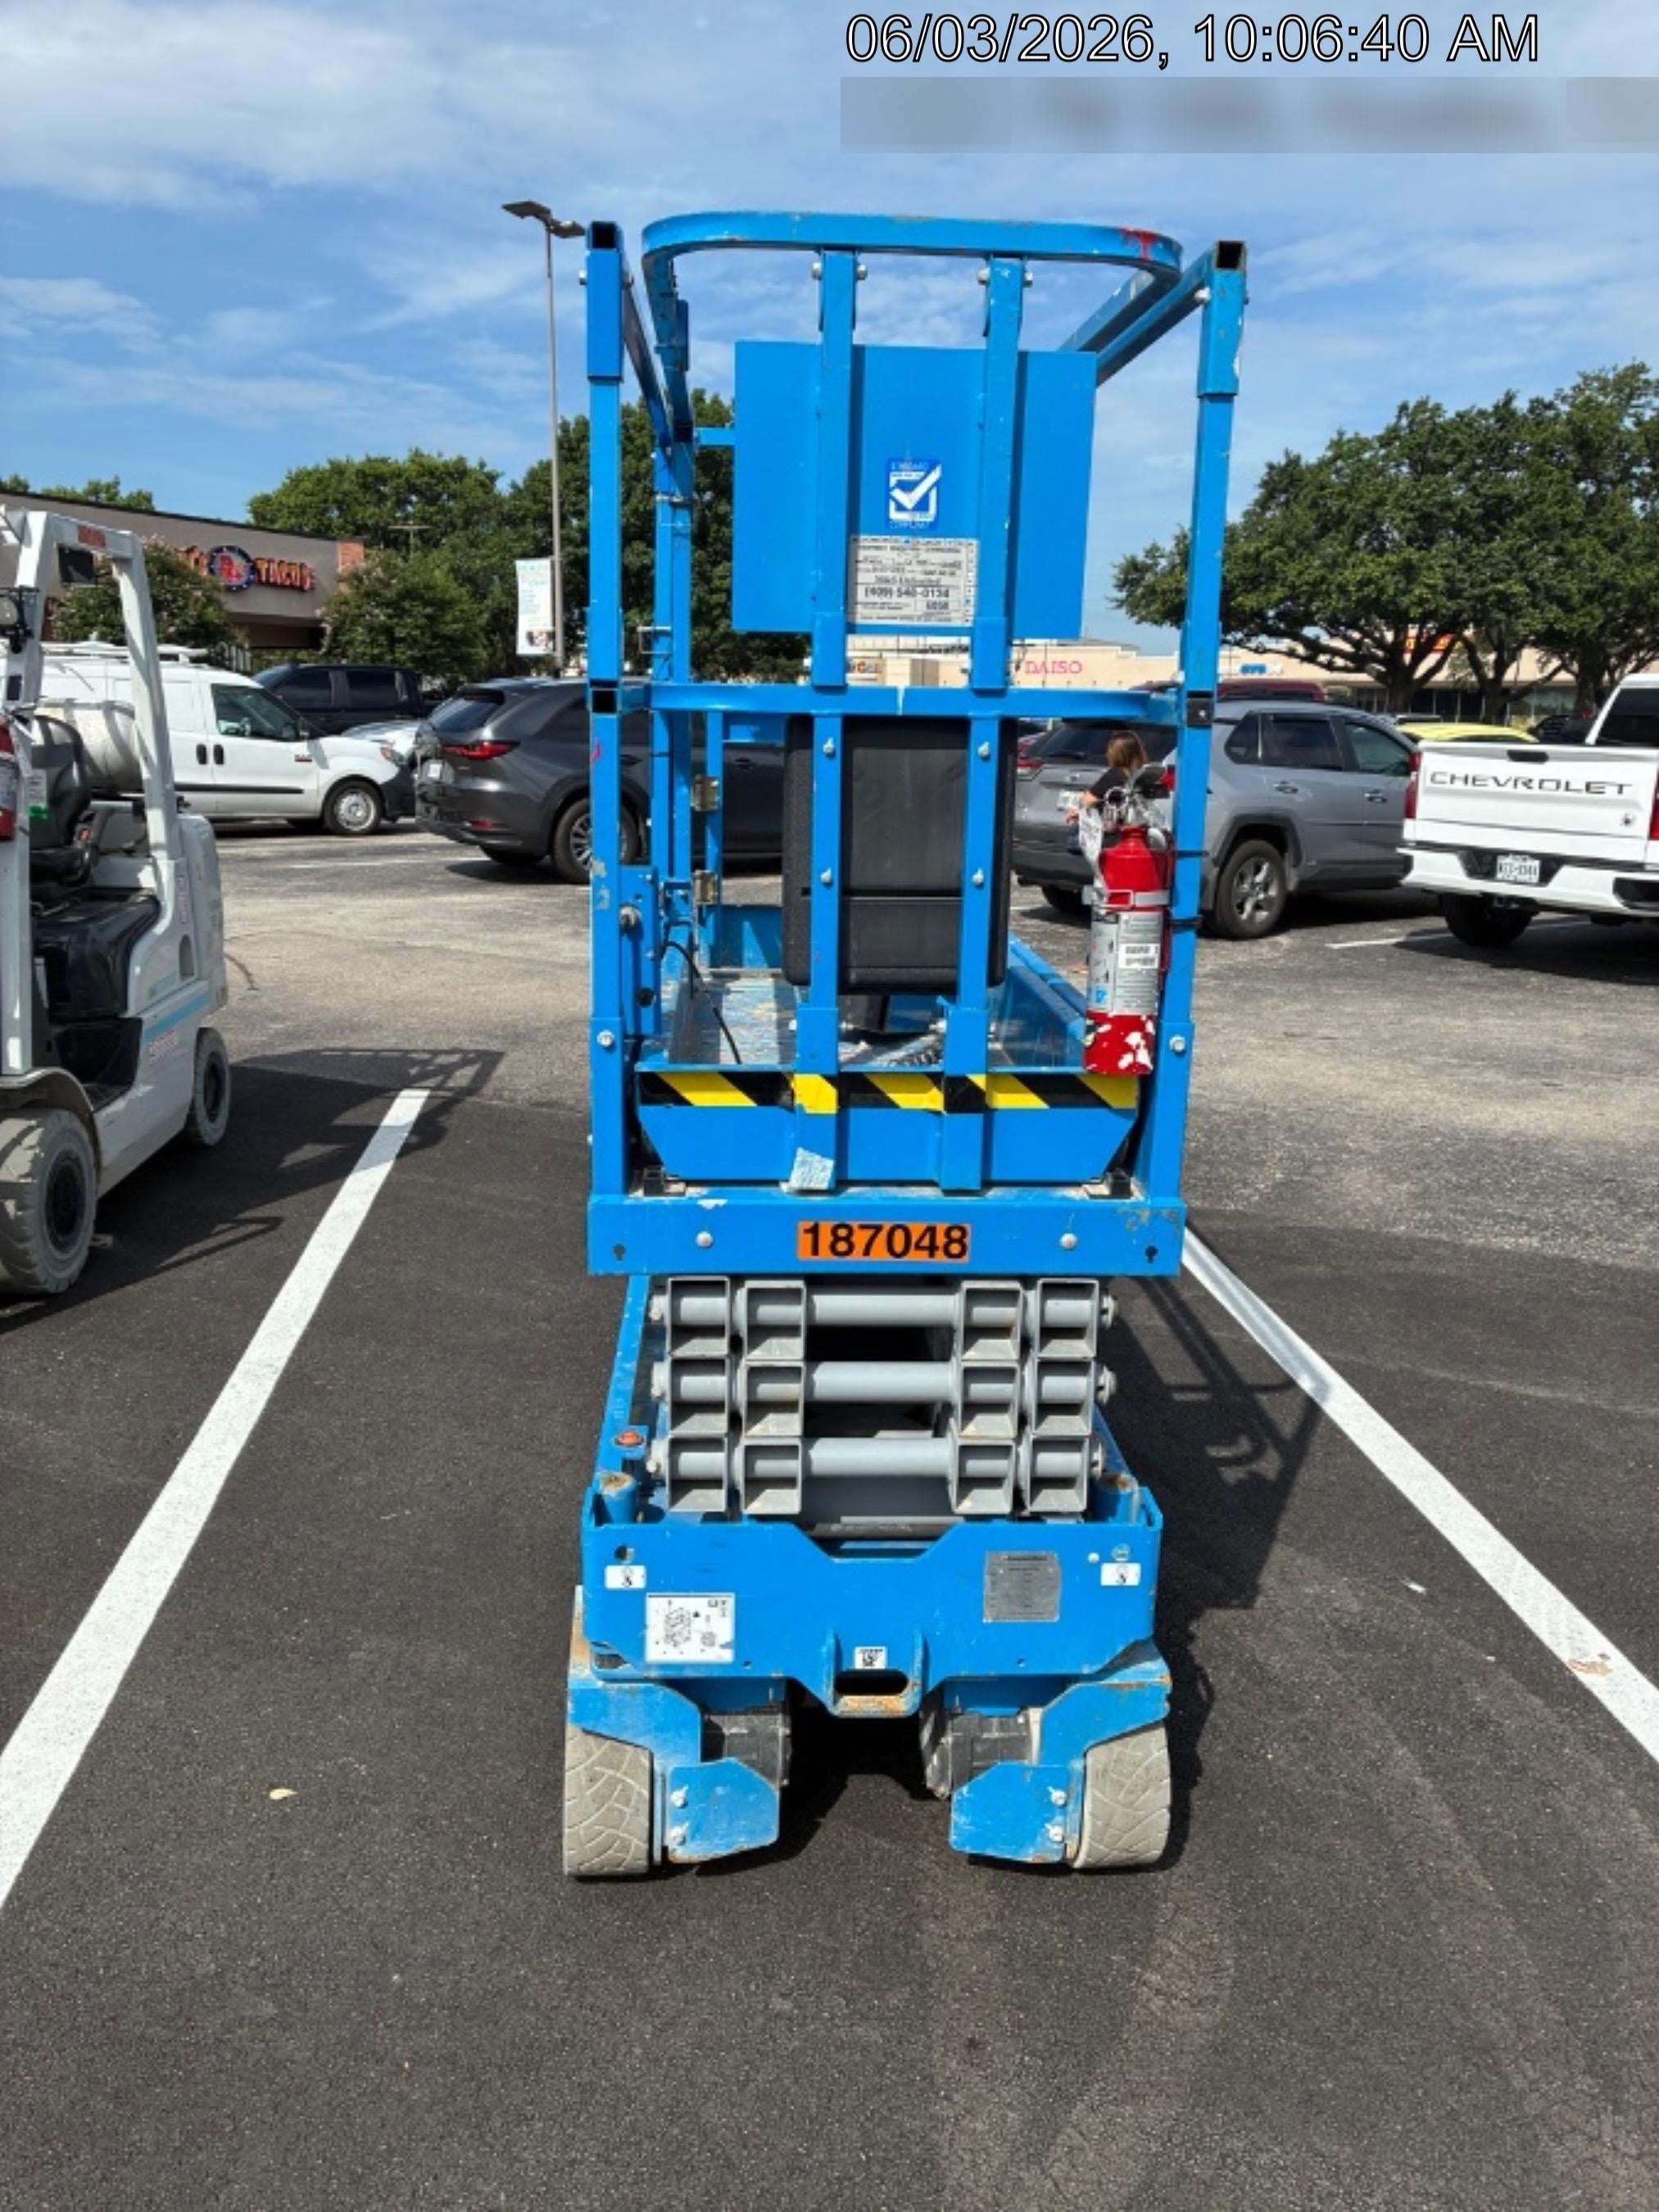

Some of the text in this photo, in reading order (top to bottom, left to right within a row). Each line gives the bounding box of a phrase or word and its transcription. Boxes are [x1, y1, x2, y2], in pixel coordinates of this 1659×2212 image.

[1025, 660, 1082, 674] DAISO
[1430, 771, 1633, 796] CHEVROLET
[803, 1222, 968, 1259] 187048
